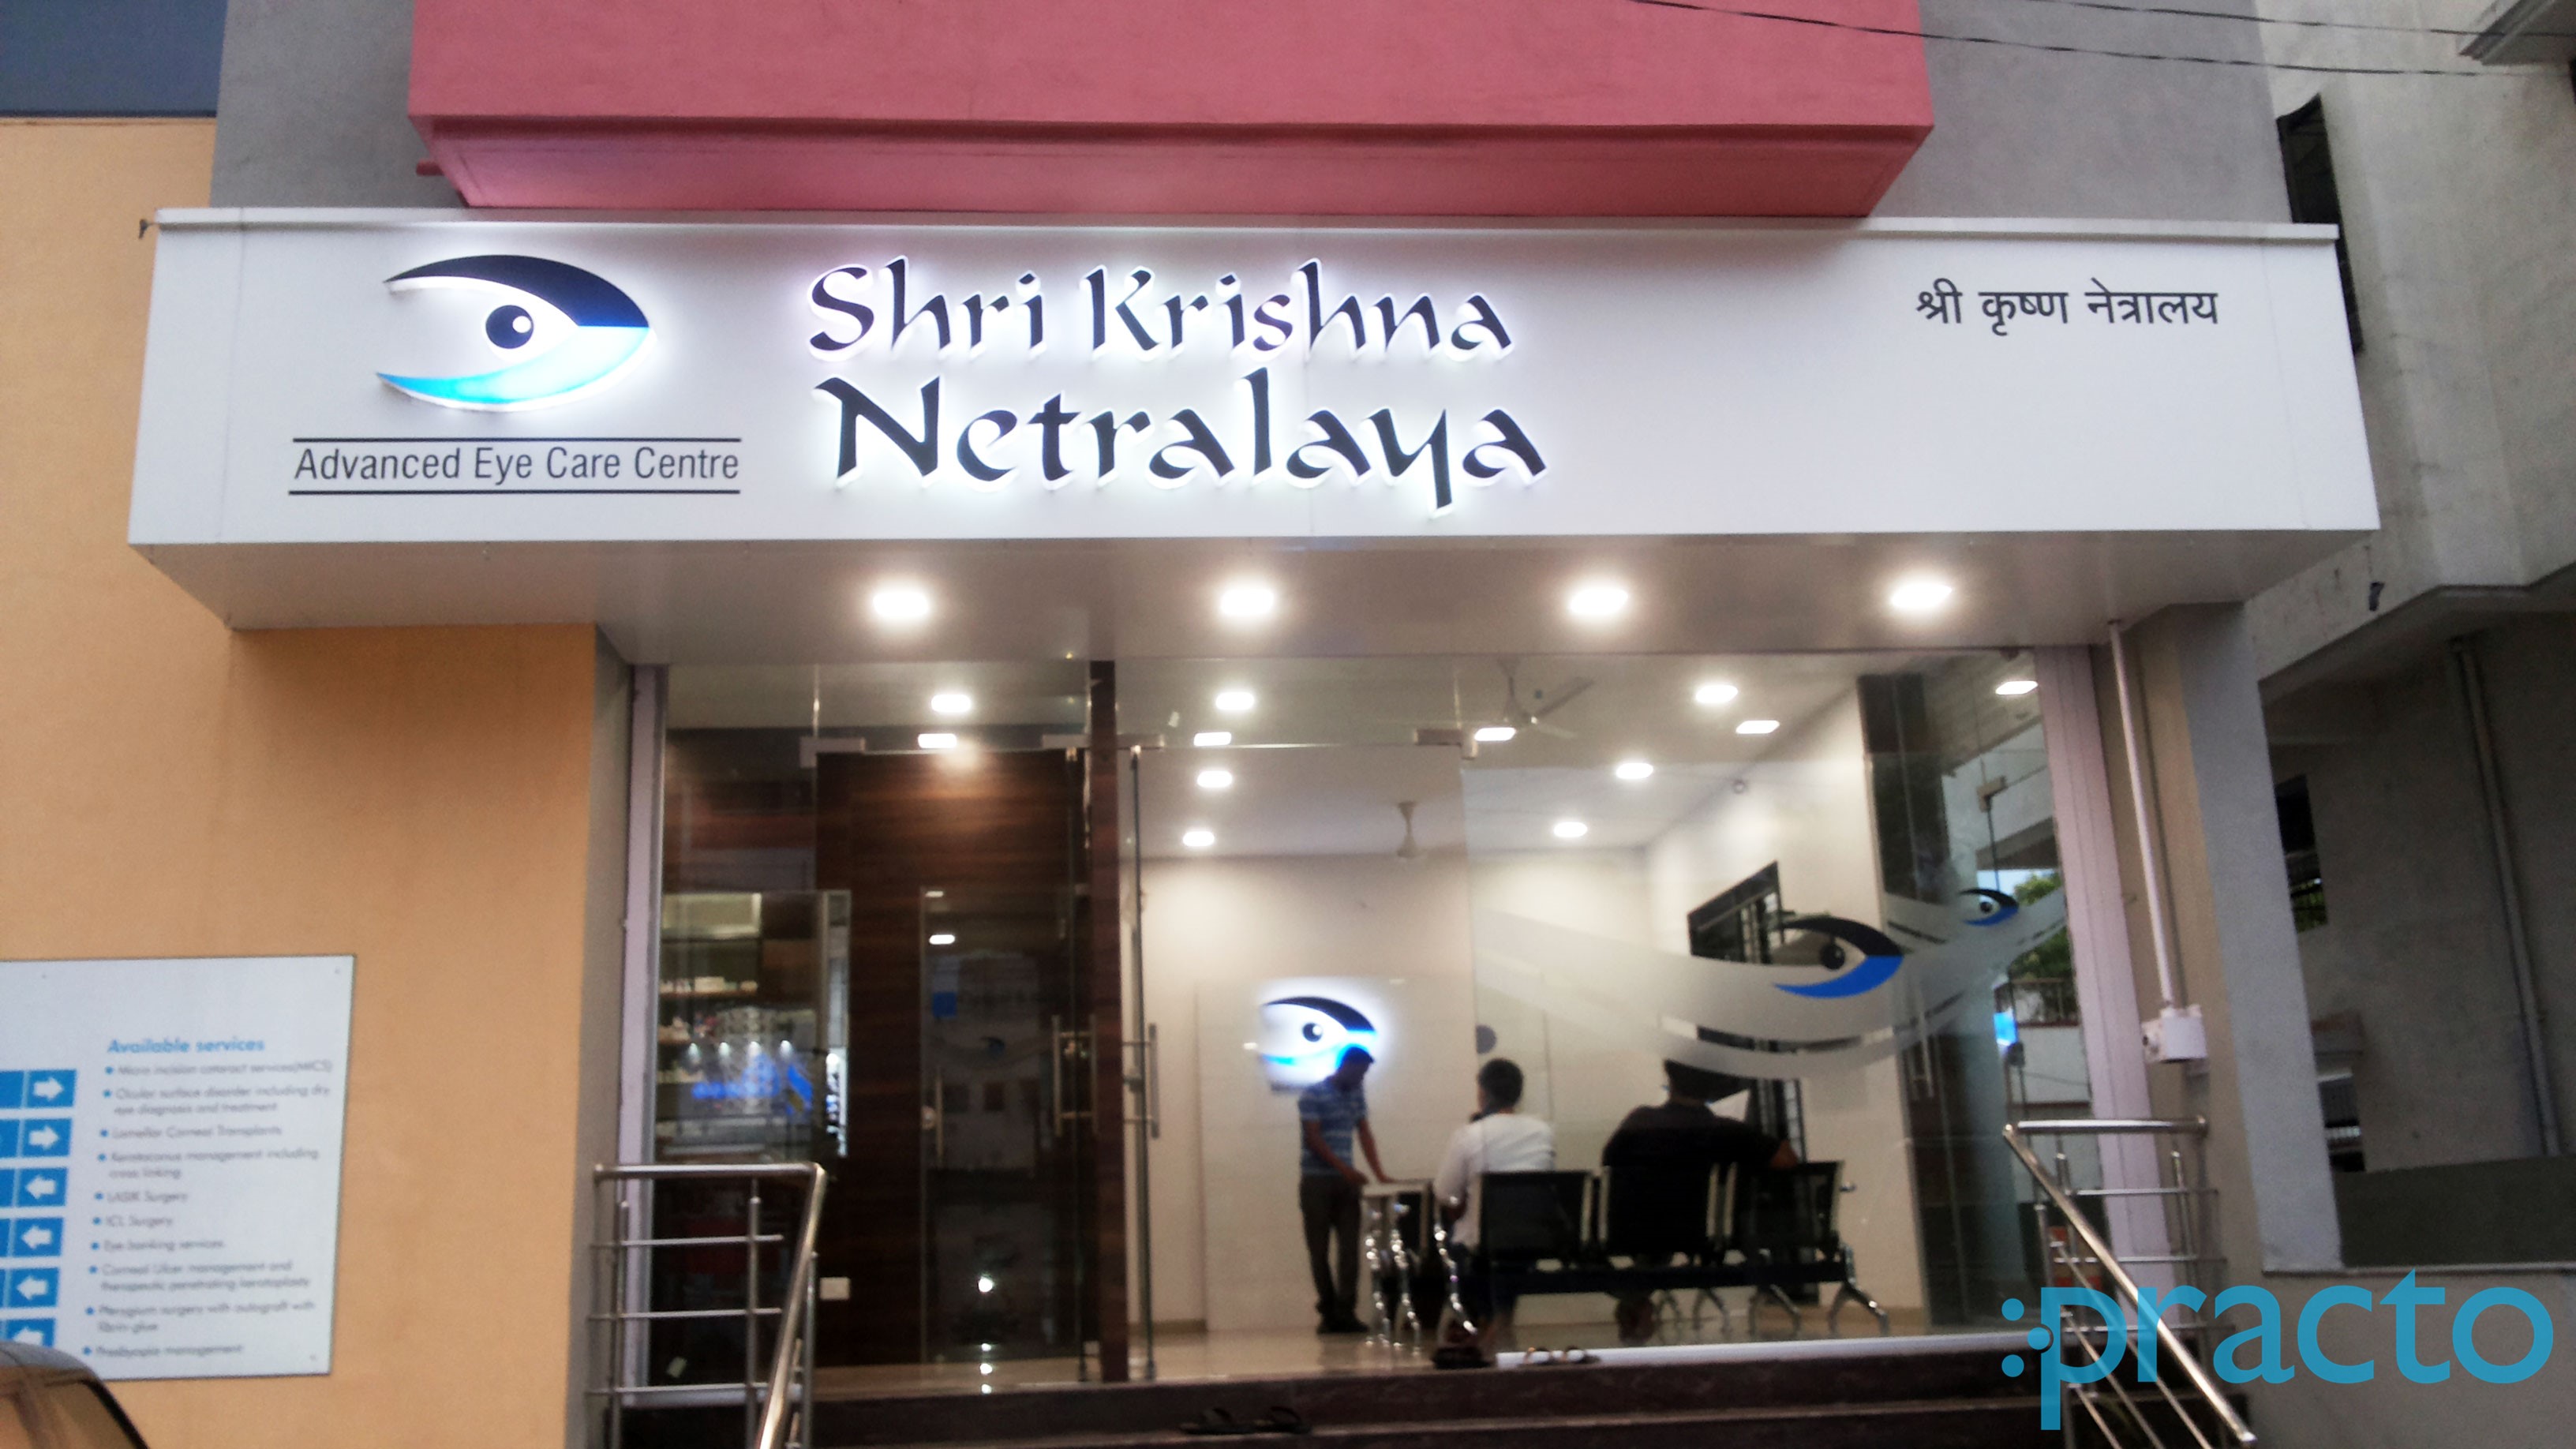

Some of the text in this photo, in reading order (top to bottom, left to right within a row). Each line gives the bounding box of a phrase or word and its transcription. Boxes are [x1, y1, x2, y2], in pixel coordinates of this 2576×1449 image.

[808, 256, 1511, 353] Shri Krishna
[1916, 277, 2219, 336] श्री कृष्ण नेत्रालय
[813, 367, 1547, 510] Netralaya
[294, 447, 739, 485] Advanced Eye Care Centre
[107, 1037, 265, 1053] Available services
[255, 1084, 309, 1097] including
[195, 1103, 219, 1114] and
[221, 1102, 278, 1112] treatment
[185, 1148, 263, 1163] management
[267, 1147, 319, 1160] including
[143, 1190, 189, 1204] Surgery
[128, 1214, 173, 1227] Surgery
[178, 1239, 224, 1249] services
[189, 1262, 265, 1275] management
[269, 1260, 294, 1271] and
[160, 1305, 204, 1318] surgery
[207, 1302, 230, 1313] with
[163, 1344, 243, 1357] management
